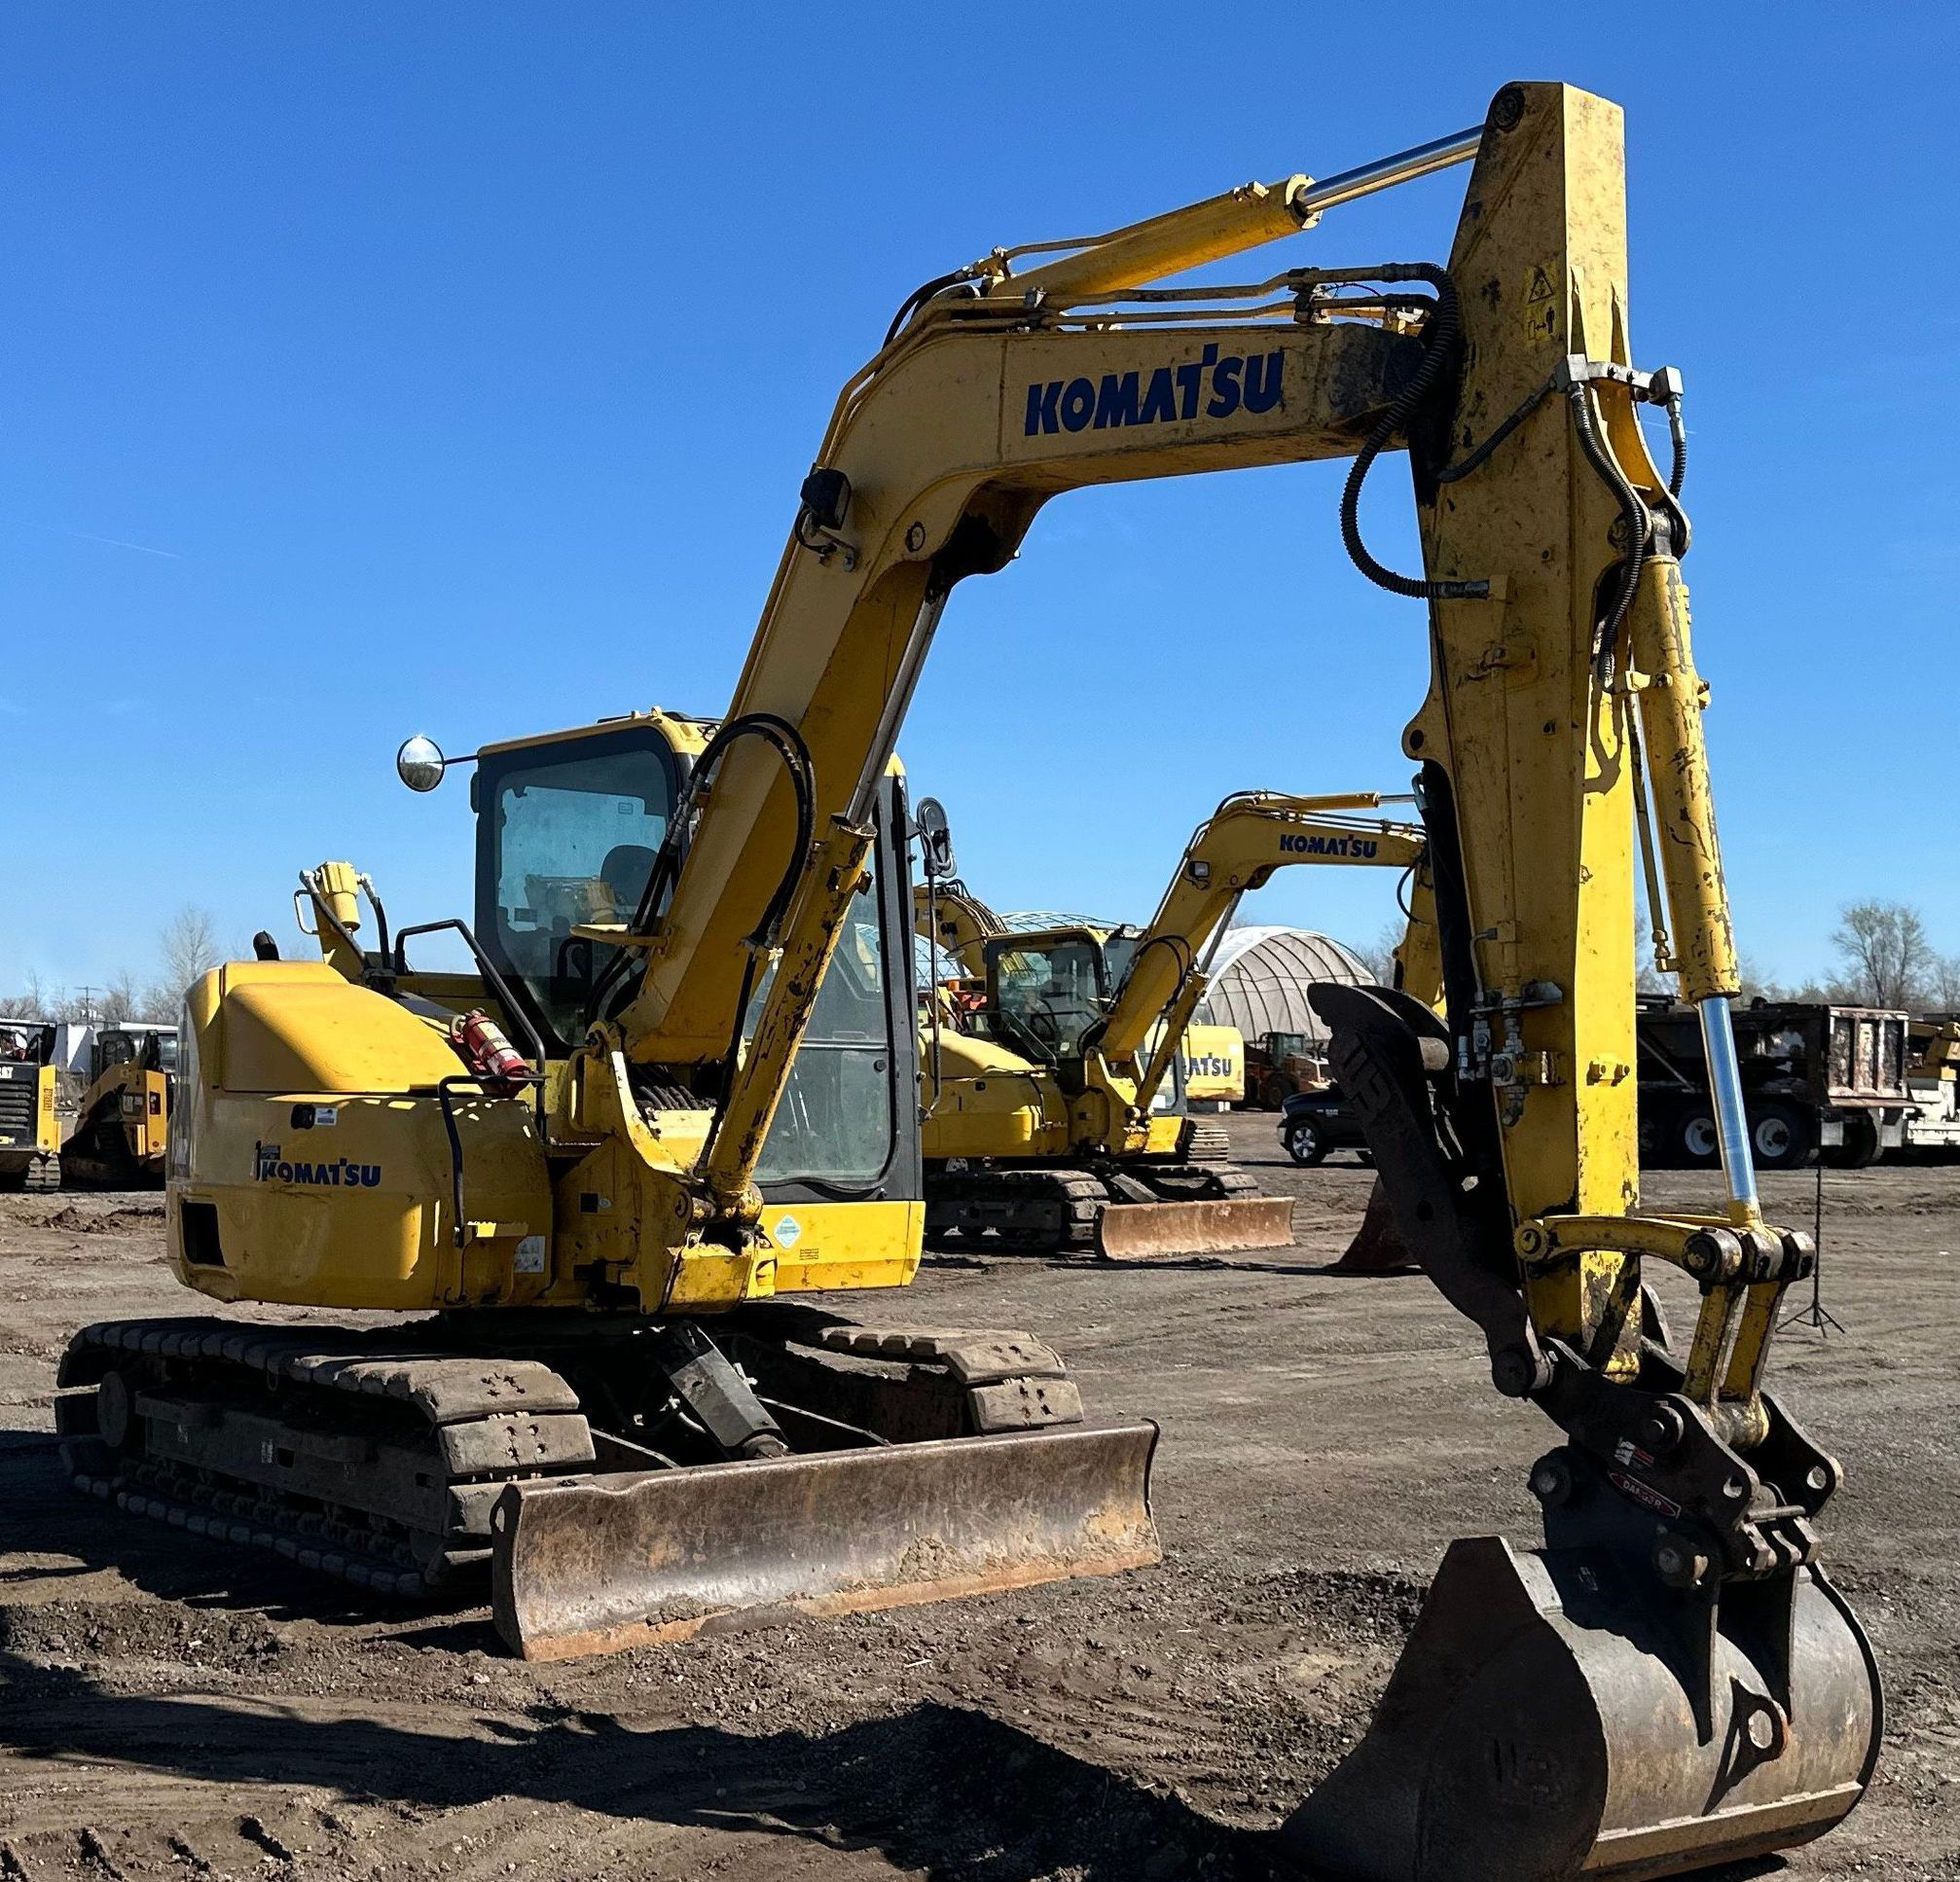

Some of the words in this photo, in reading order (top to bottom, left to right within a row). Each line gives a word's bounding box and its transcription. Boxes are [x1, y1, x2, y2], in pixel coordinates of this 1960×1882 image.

[1025, 344, 1285, 436] KOMATSU
[1280, 834, 1378, 858] KOMATSU
[1188, 1052, 1232, 1077] ATSU
[262, 1158, 381, 1187] KOMATSU
[1623, 1480, 1662, 1509] DANGER
